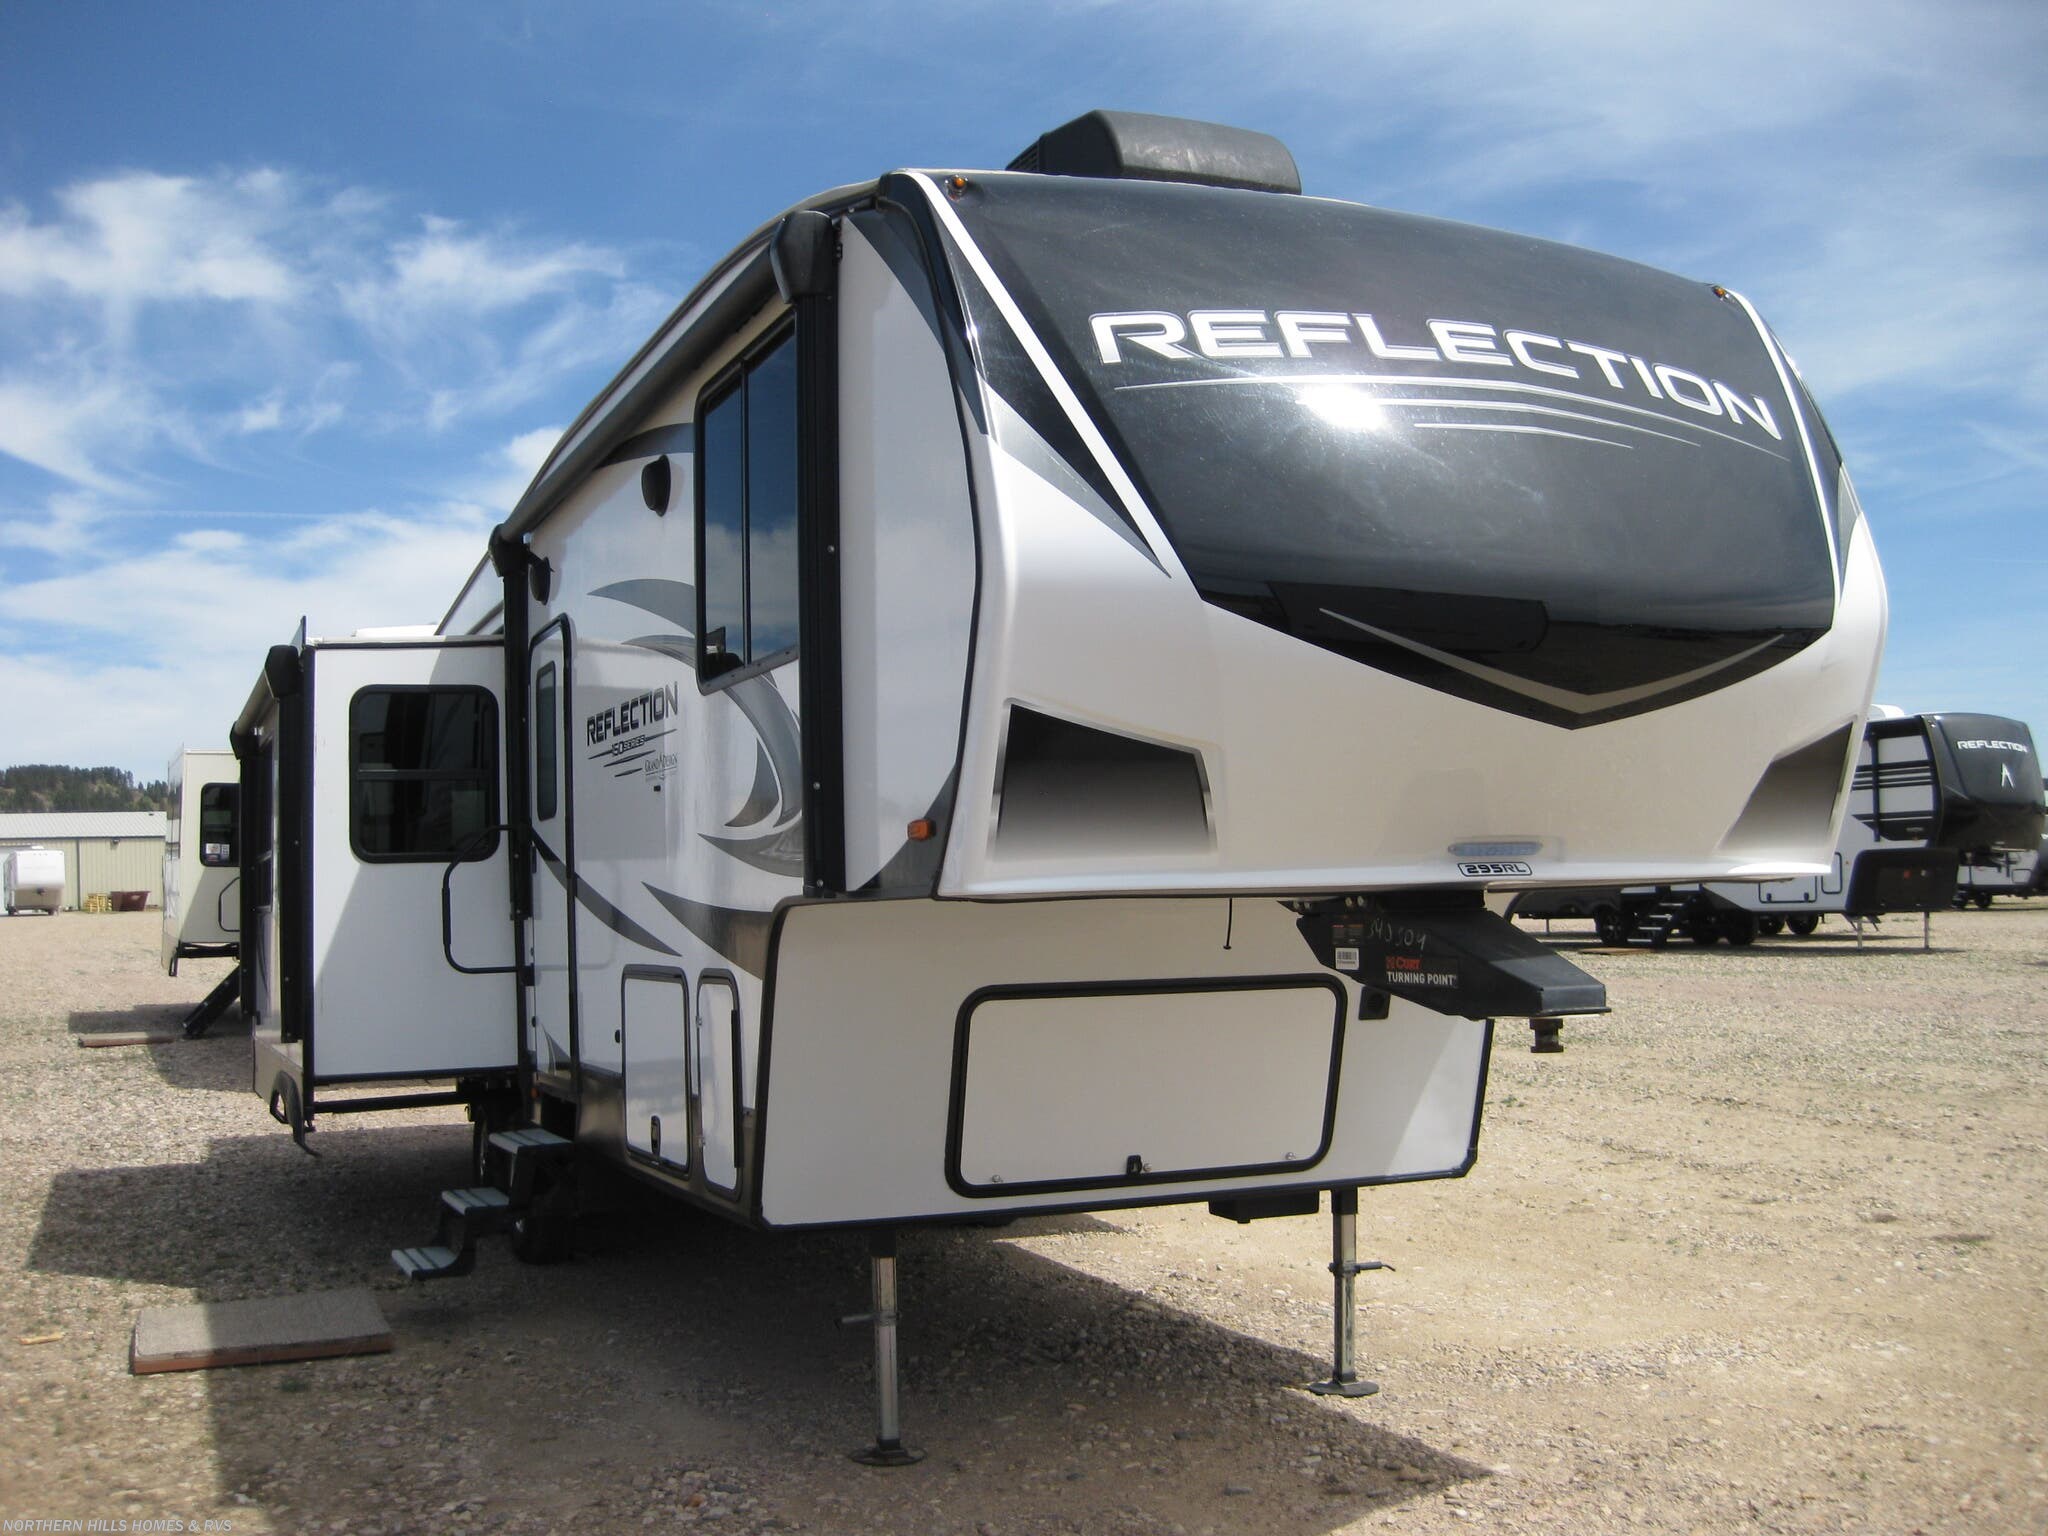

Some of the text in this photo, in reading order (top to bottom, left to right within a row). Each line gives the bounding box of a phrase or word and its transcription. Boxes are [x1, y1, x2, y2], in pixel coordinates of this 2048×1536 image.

[1088, 309, 1782, 440] REFLECTION
[586, 681, 678, 747] REFLECTION
[1957, 740, 2028, 752] REFLECTION
[1464, 864, 1526, 873] 295RL
[1386, 971, 1425, 984] TURNING
